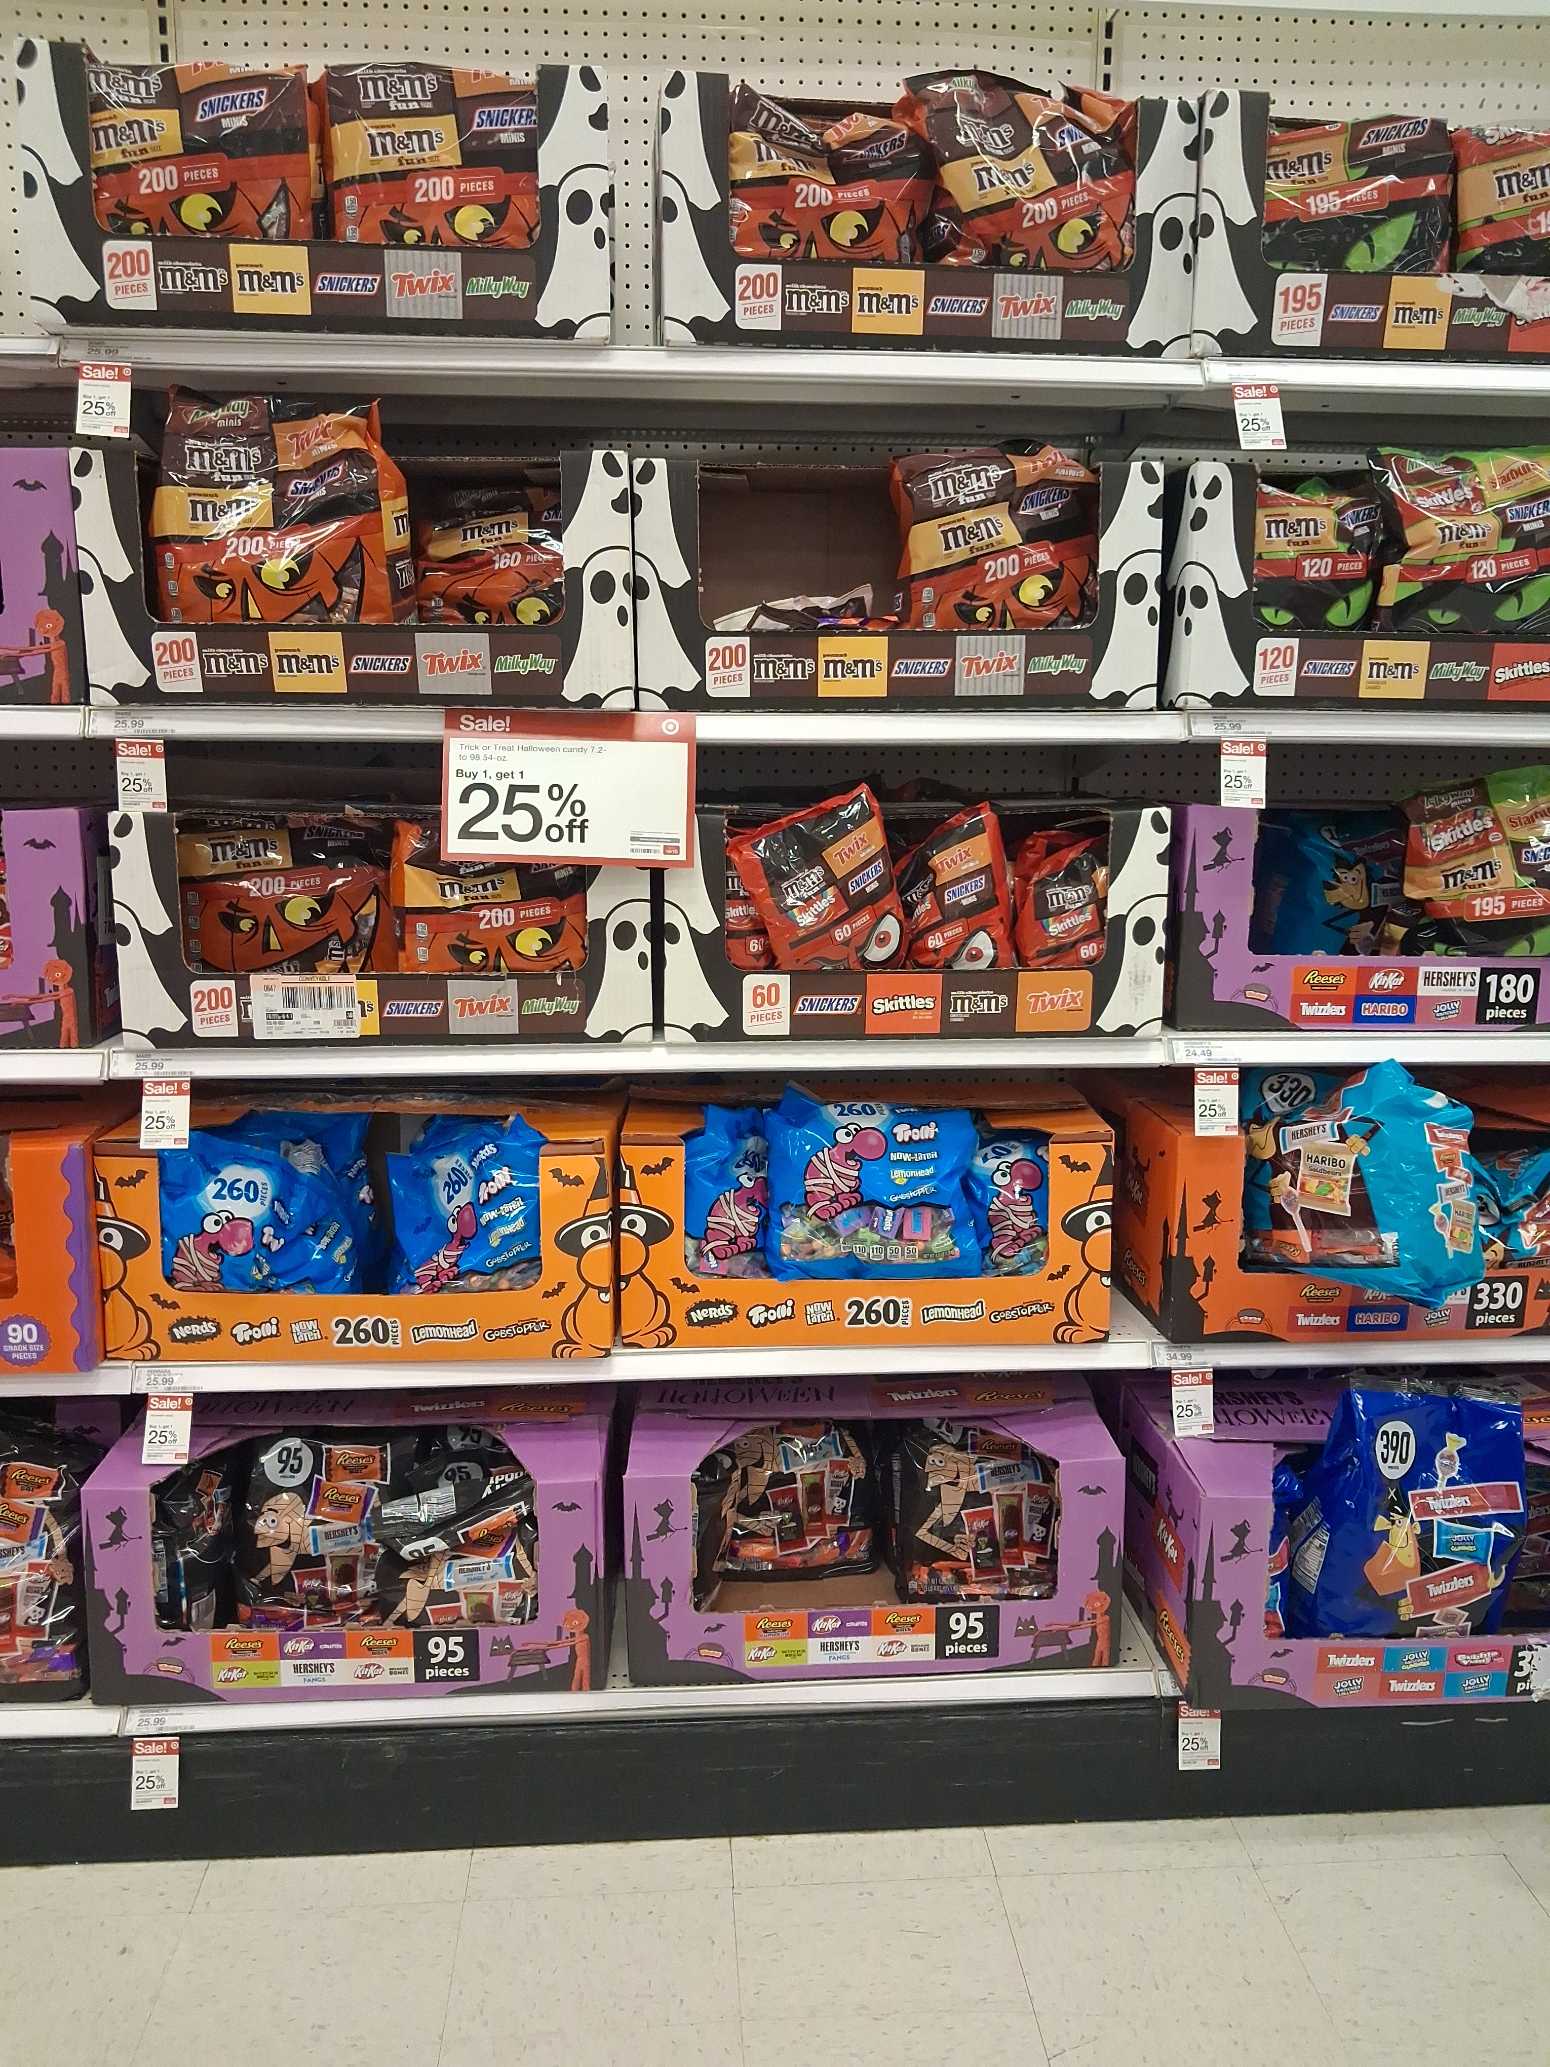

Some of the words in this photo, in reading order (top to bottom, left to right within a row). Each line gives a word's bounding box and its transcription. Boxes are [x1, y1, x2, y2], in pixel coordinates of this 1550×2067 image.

[358, 74, 437, 100] m&m's
[199, 89, 266, 121] SNICKERS
[1362, 118, 1428, 146] SNICKERS
[368, 130, 444, 158] m&m's
[138, 166, 178, 194] 200
[184, 168, 219, 182] PIECES
[414, 176, 454, 202] 200
[460, 180, 495, 193] PIECES
[795, 183, 833, 208] 200
[837, 188, 870, 199] PIECES
[1022, 198, 1057, 228] 200
[1061, 192, 1089, 209] PIECES
[107, 249, 150, 278] 200
[114, 282, 148, 296] PIECES
[158, 267, 228, 292] m&m's
[237, 268, 305, 293] m&m's
[316, 274, 379, 294] SNICKERS
[391, 270, 456, 297] Twix
[738, 272, 778, 300] 200
[786, 289, 849, 313] m&m's
[858, 292, 919, 315] m&m's
[930, 297, 988, 314] SNICKERS
[999, 292, 1056, 320] Twix
[1279, 284, 1322, 314] 195
[744, 304, 774, 316] PIECES
[1330, 305, 1382, 320] SNICKERS
[1394, 307, 1443, 325] m&m's
[1280, 319, 1316, 331] PIECES
[82, 365, 118, 380] Sale!
[1234, 385, 1267, 398] Sale!
[461, 520, 519, 544] m&m's
[940, 515, 1004, 552] m&m's
[1264, 517, 1326, 539] m&m's
[226, 536, 263, 558] 200
[492, 552, 521, 570] 160
[984, 554, 1020, 583] 200
[1023, 552, 1050, 567] PIECES
[1302, 558, 1332, 577] 120
[1337, 562, 1362, 571] PIECES
[1471, 559, 1497, 579] 120
[1501, 558, 1530, 571] PIECES
[156, 638, 195, 665] 200
[708, 644, 746, 671] 200
[1259, 645, 1294, 671] 120
[203, 652, 269, 675] m&m's
[276, 653, 340, 675] m&m's
[351, 656, 411, 673] SNICKERS
[423, 649, 483, 676] Twix
[753, 658, 815, 680] m&m's
[823, 658, 882, 680] m&m's
[894, 660, 951, 677] SNICKERS
[961, 651, 1019, 679] Twix
[1304, 661, 1354, 676] SNICKERS
[1368, 661, 1419, 680] m&m's
[163, 668, 194, 680] PIECES
[713, 673, 743, 685] PIECES
[1261, 674, 1289, 684] PIECES
[115, 720, 144, 728] 25.99
[459, 715, 511, 732] Sale!
[118, 743, 152, 756] Sale!
[518, 744, 560, 752] Halloween
[562, 746, 588, 754] candy
[1222, 742, 1254, 755] Sale!
[456, 769, 478, 780] Buy
[482, 770, 492, 779] 1,
[496, 771, 514, 780] get
[519, 771, 524, 779] 1
[545, 819, 589, 843] off
[833, 833, 868, 865] Twix
[938, 847, 972, 873] Twix
[250, 876, 285, 896] 200
[290, 878, 320, 888] PIECES
[850, 862, 883, 892] SNICKERS
[946, 877, 984, 903] SNICKERS
[797, 895, 835, 926] Skittles
[1471, 896, 1505, 917] 195
[1512, 897, 1543, 909] PIECES
[479, 907, 515, 929] 200
[520, 907, 551, 918] PIECES
[1049, 911, 1092, 935] Skittles
[835, 925, 851, 940] 60
[928, 932, 942, 948] 60
[1080, 943, 1097, 958] 60
[1424, 971, 1476, 987] HERSHEY'S
[1486, 974, 1534, 1004] 180
[193, 987, 233, 1012] 200
[752, 982, 780, 1007] 60
[796, 996, 859, 1013] SNICKERS
[873, 993, 936, 1014] Skittles
[1028, 989, 1083, 1014] Twix
[386, 1002, 443, 1015] SNICKERS
[454, 994, 512, 1018] Twix
[1301, 1003, 1346, 1016] Twizzlers
[1362, 1003, 1408, 1016] HARIBO
[1433, 1000, 1461, 1013] JOLLY
[1486, 1007, 1526, 1020] pieces
[200, 1014, 231, 1025] PIECES
[750, 1011, 783, 1023] PIECES
[1197, 1073, 1228, 1083] Sale!
[144, 1083, 177, 1094] Sale!
[1268, 1076, 1312, 1107] 330
[893, 1122, 937, 1142] Trolli
[1291, 1124, 1327, 1140] HERSHEY'S
[1307, 1154, 1346, 1169] HARIBO
[212, 1178, 260, 1204] 260
[1473, 1282, 1523, 1310] 330
[748, 1301, 794, 1326] Trolli
[847, 1300, 900, 1325] 260
[1296, 1313, 1340, 1326] Twizzlers
[1355, 1313, 1400, 1324] HARIBO
[1425, 1308, 1451, 1320] JOLLY
[1476, 1313, 1515, 1327] pieces
[8, 1324, 37, 1343] 90
[231, 1318, 279, 1344] Trolli
[335, 1318, 388, 1344] 260
[392, 1320, 400, 1345] PIECES
[1173, 1374, 1203, 1385] Sale!
[150, 1398, 181, 1409] Sale!
[1380, 1430, 1410, 1466] 390
[277, 1447, 302, 1473] 95
[1427, 1495, 1471, 1509] Twizzlers
[1427, 1575, 1473, 1595] Twizzlers
[950, 1612, 984, 1640] 95
[428, 1636, 465, 1664] 95
[820, 1641, 860, 1652] HERSHEY'S
[945, 1642, 988, 1656] pieces
[1403, 1651, 1429, 1661] JOLLY
[293, 1663, 335, 1674] HERSHEY'S
[1327, 1655, 1375, 1667] Twizzlers
[425, 1667, 470, 1679] pieces
[1335, 1677, 1363, 1689] JOLLY
[1463, 1675, 1491, 1687] JOLLY
[1389, 1680, 1436, 1692] Twizzlers
[135, 1743, 166, 1753] Sale!
